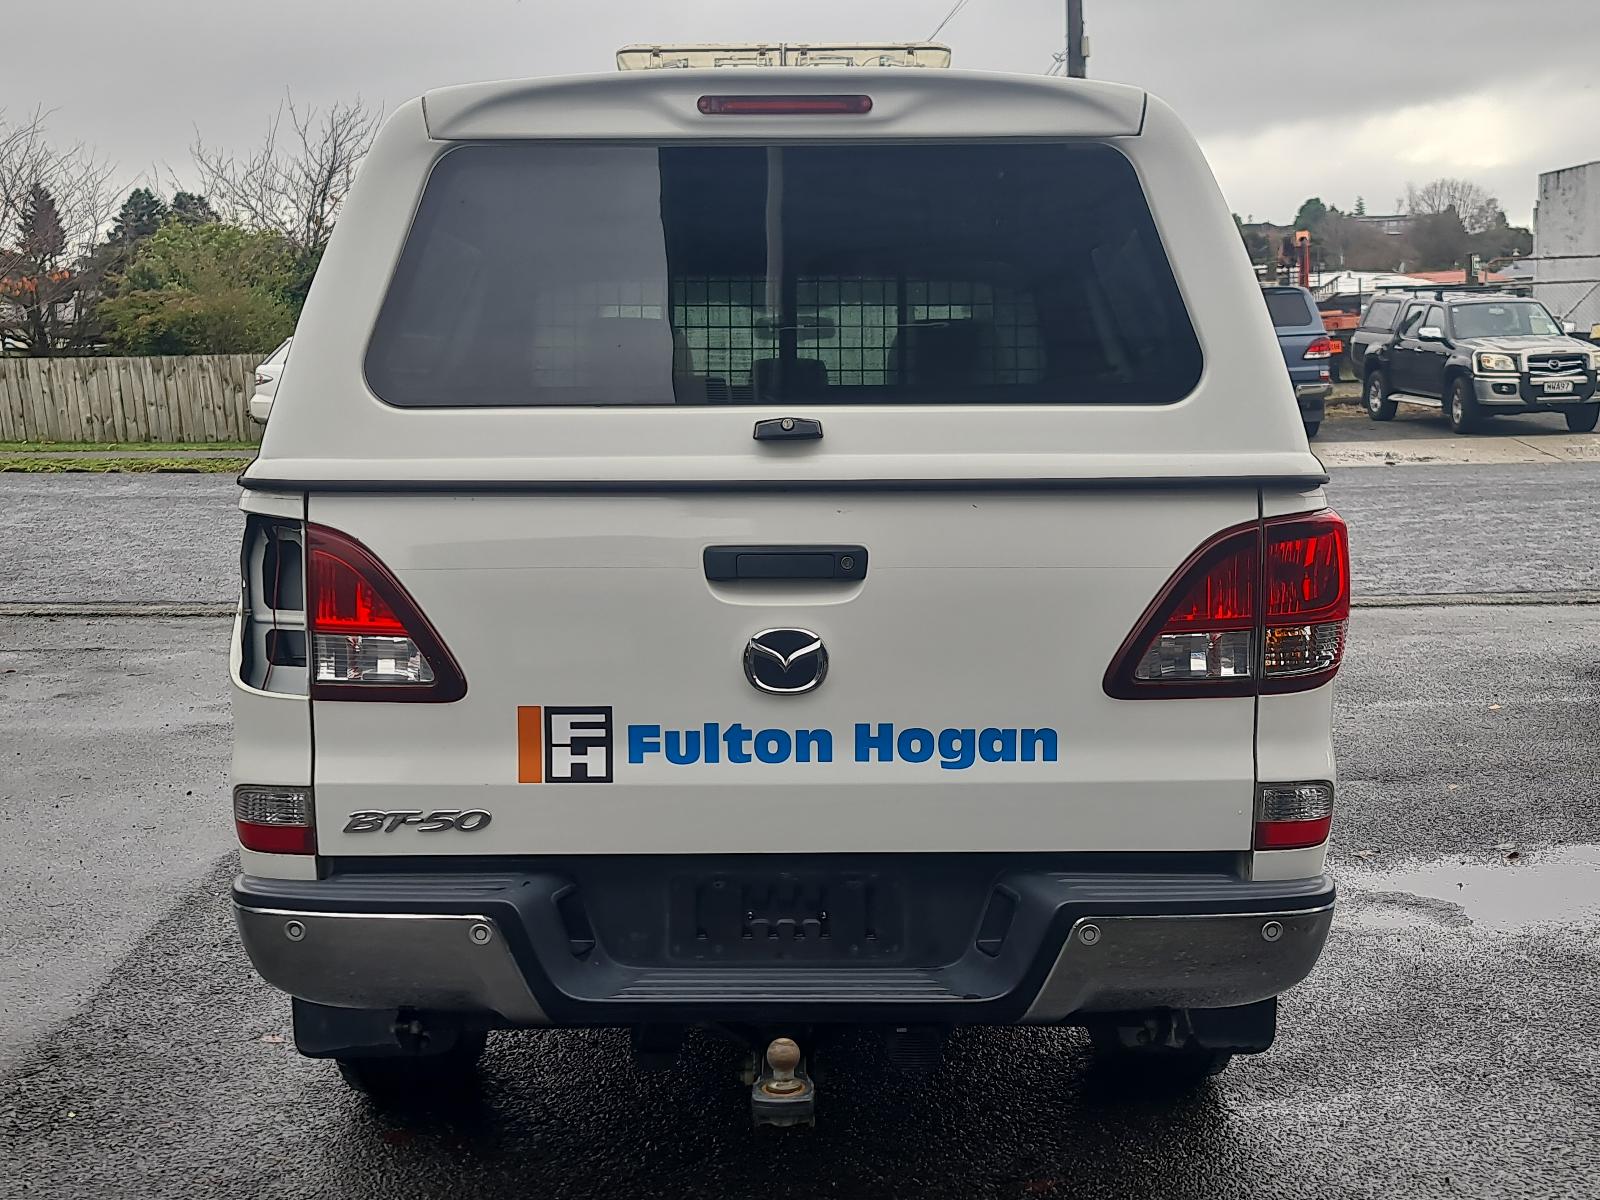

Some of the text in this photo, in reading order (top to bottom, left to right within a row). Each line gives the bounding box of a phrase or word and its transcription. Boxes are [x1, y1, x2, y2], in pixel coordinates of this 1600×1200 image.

[627, 722, 1057, 769] Fulton Hogan
[342, 808, 493, 833] BT-50
